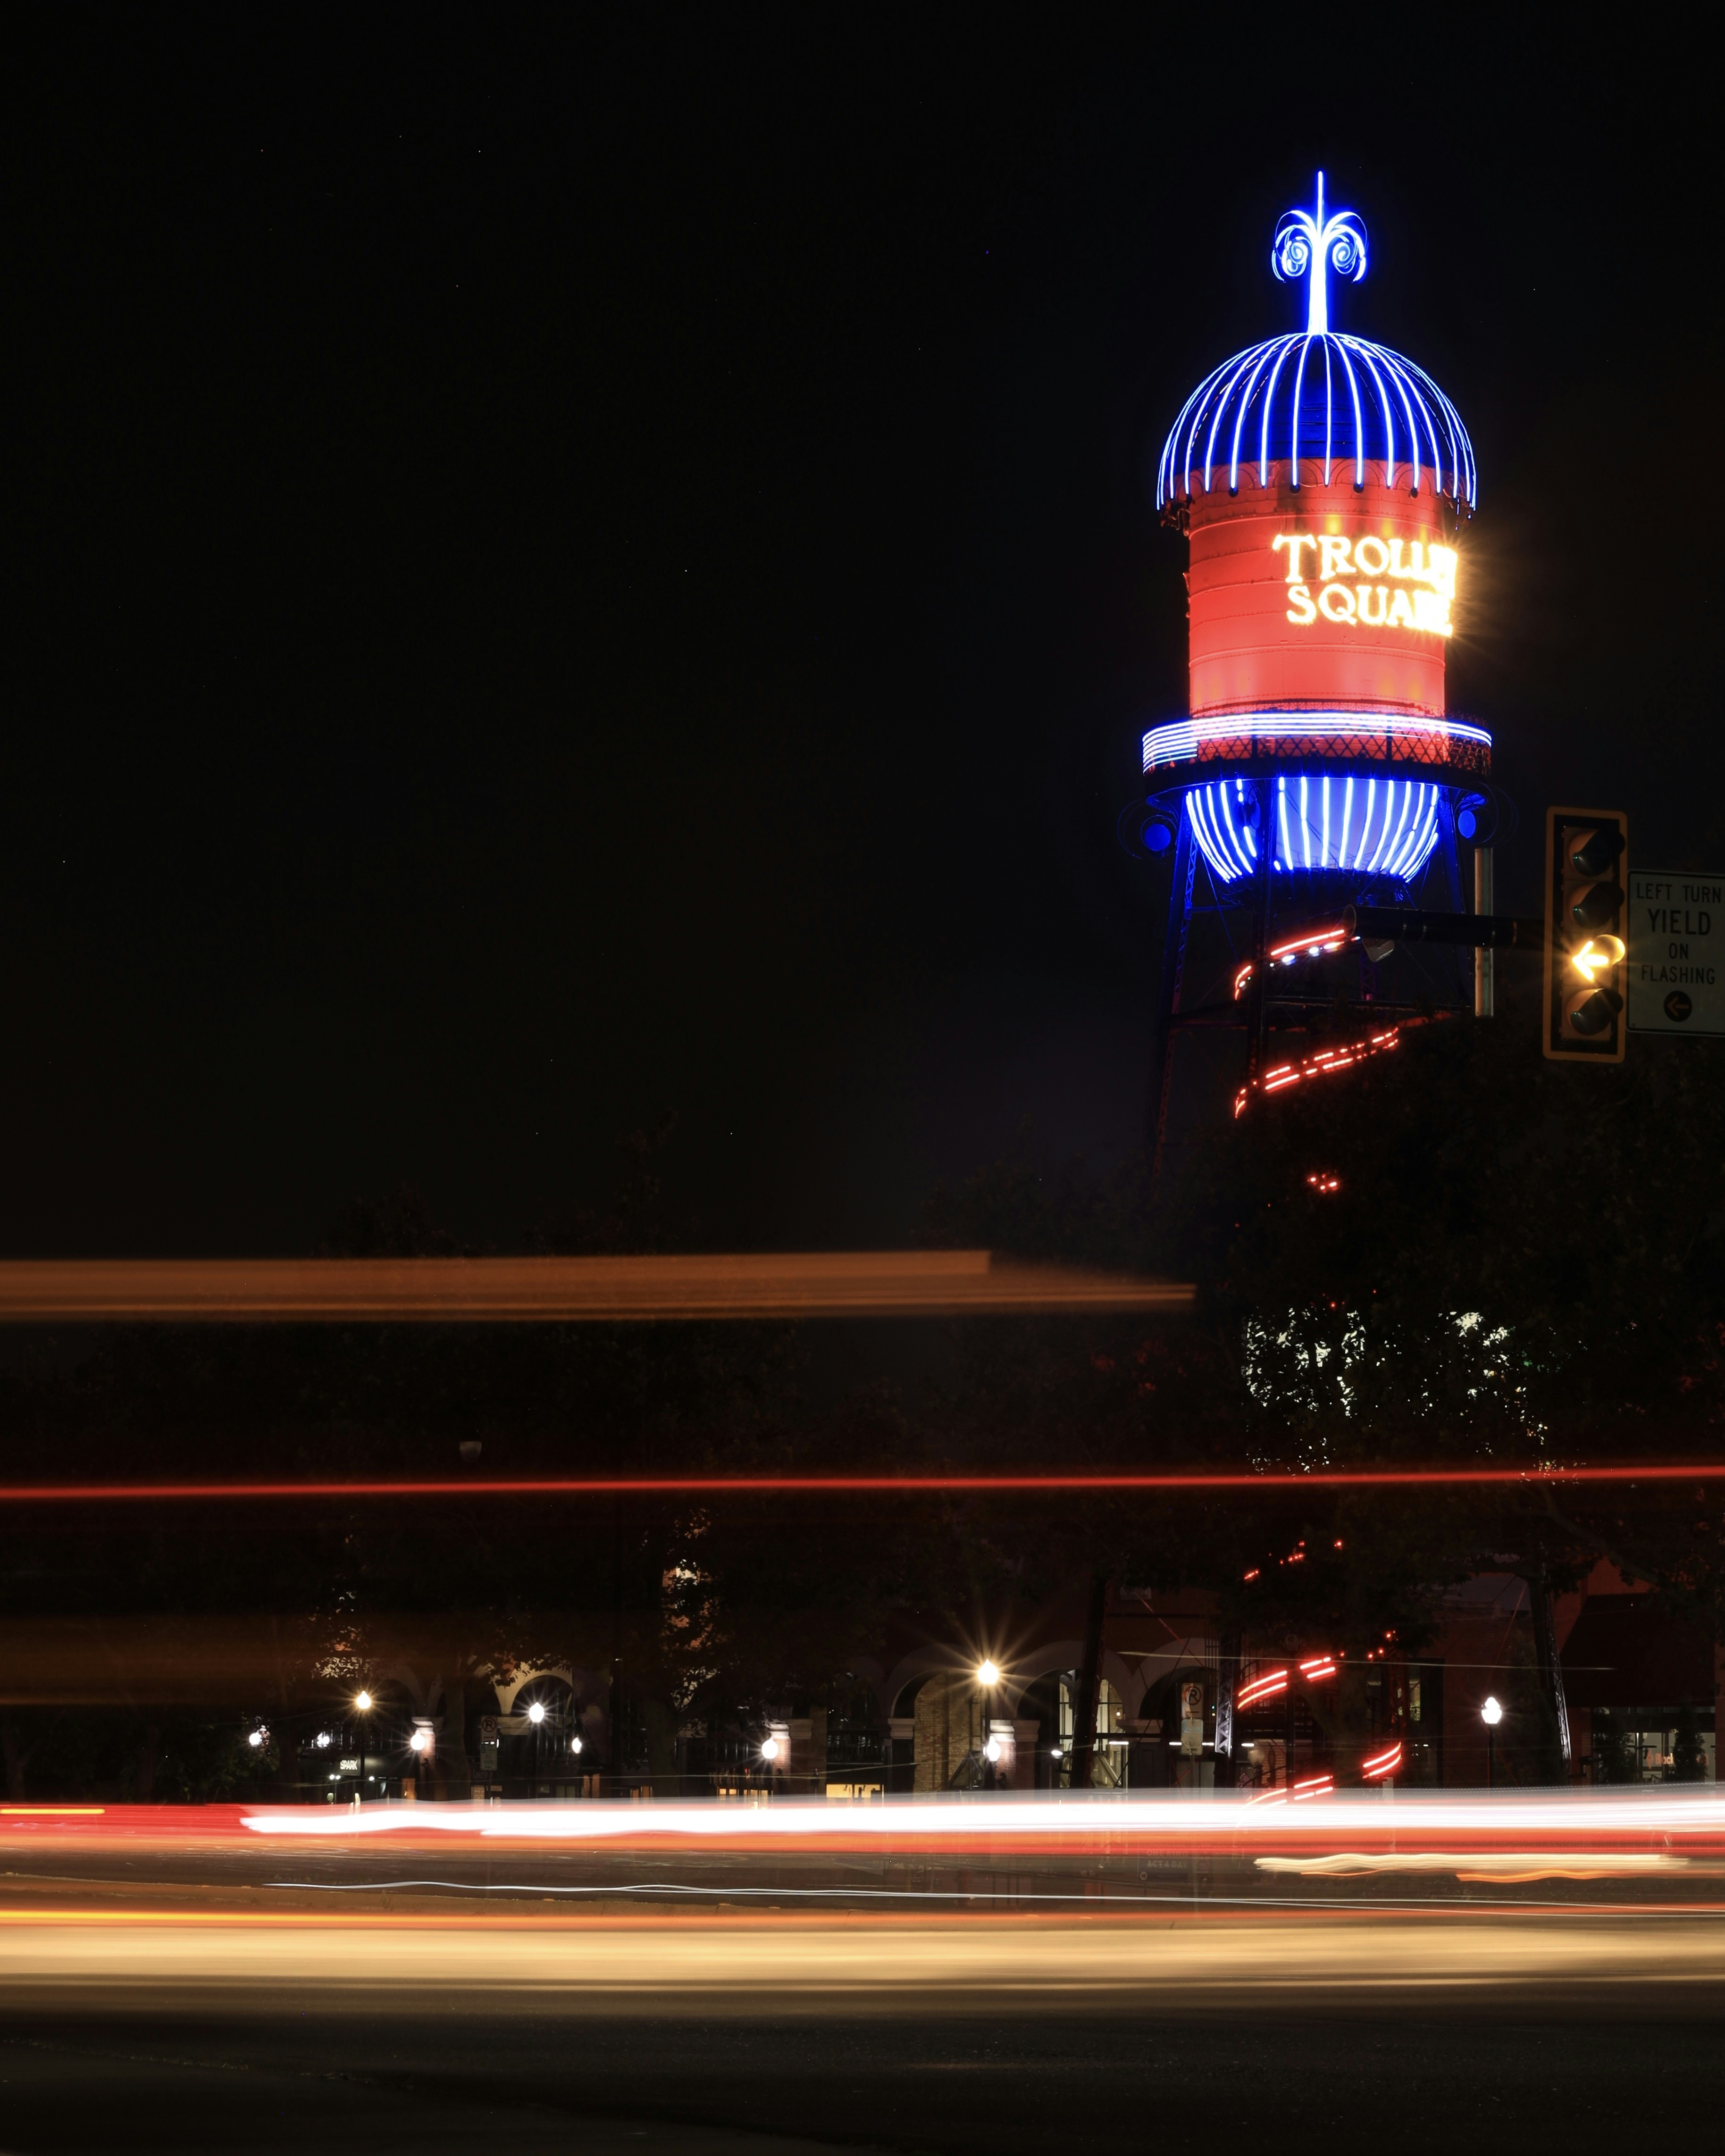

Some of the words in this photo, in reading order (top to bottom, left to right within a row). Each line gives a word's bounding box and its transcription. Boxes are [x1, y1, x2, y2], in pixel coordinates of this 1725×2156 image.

[1636, 882, 1672, 901] LEFT
[1683, 885, 1721, 903] TURN
[1647, 908, 1711, 936] YIELD
[1669, 942, 1689, 960] ON
[1641, 964, 1715, 985] FLASHING
[340, 1760, 358, 1770] SPARK
